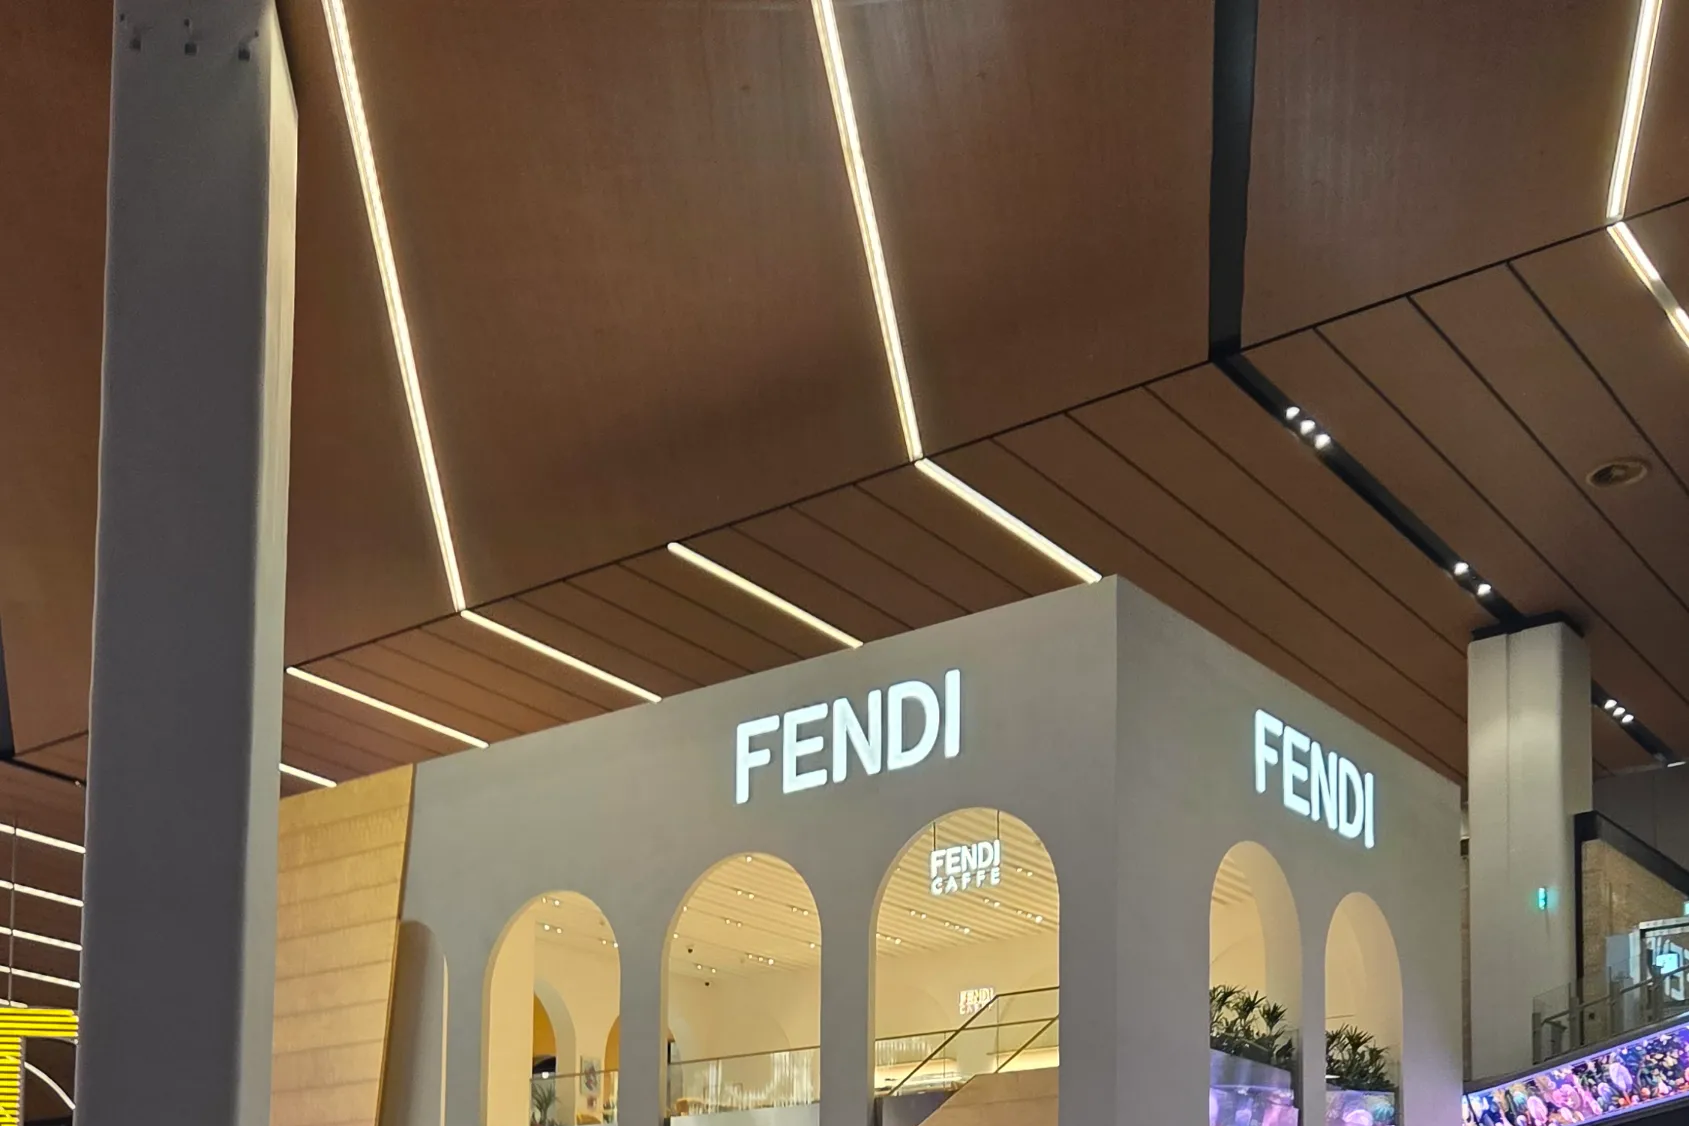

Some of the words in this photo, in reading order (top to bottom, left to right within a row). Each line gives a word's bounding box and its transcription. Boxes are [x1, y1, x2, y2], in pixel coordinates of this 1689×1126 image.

[736, 669, 960, 804] FENDI
[1255, 709, 1374, 849] FENDI
[930, 840, 1000, 878] FENDI
[931, 867, 1000, 895] CAFFE
